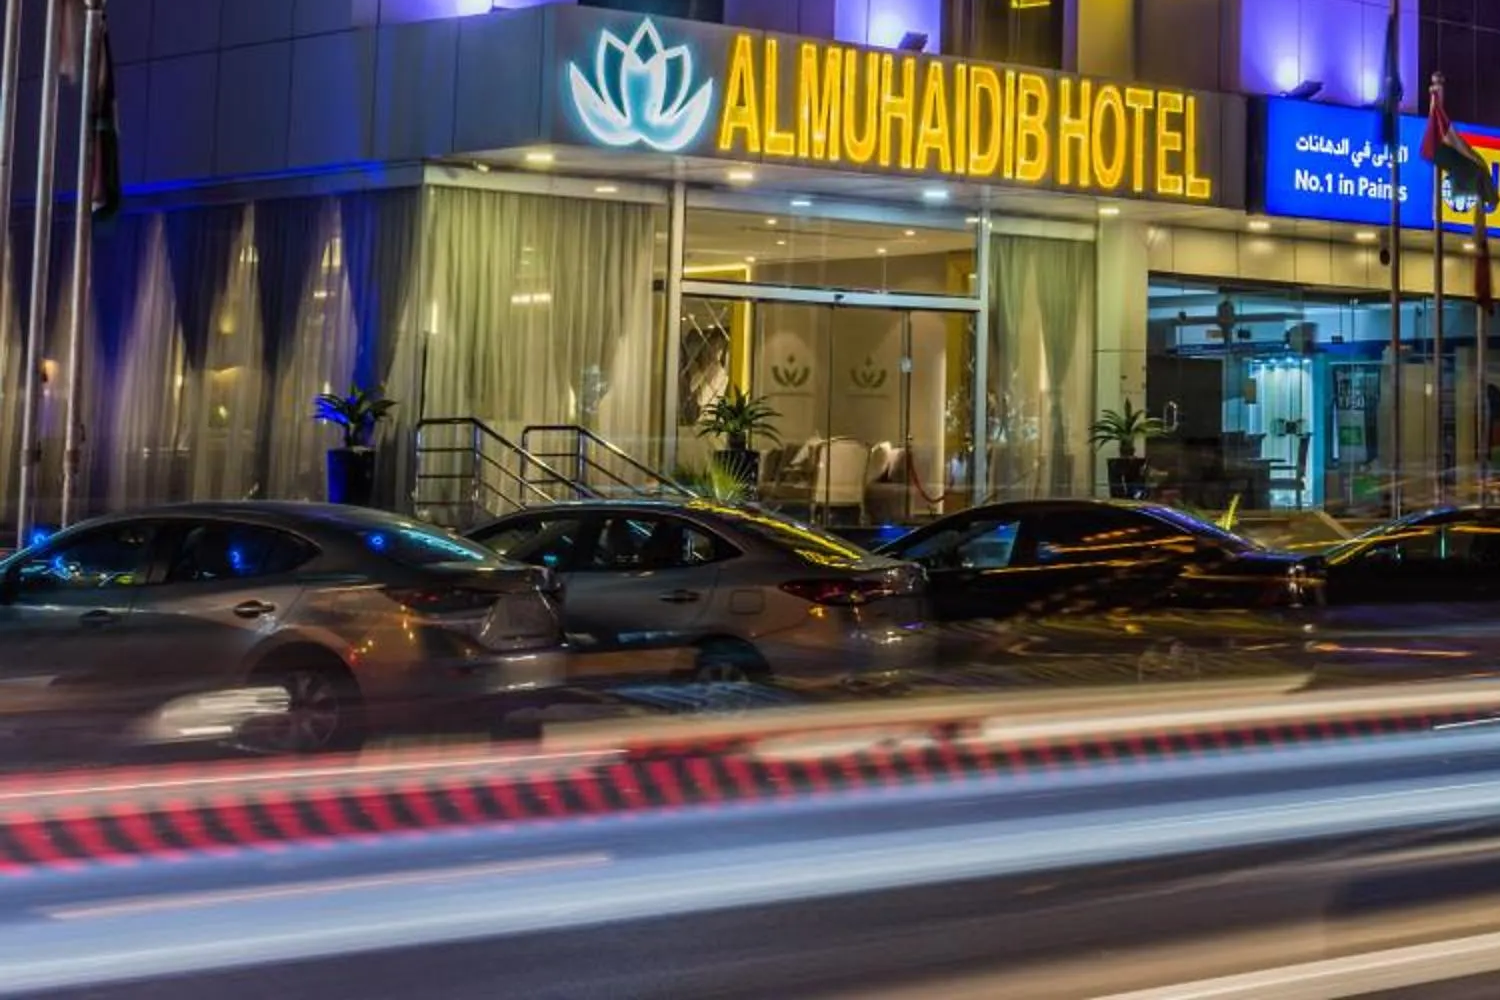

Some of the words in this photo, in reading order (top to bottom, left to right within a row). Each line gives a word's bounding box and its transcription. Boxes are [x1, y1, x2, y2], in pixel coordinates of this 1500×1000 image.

[1059, 79, 1212, 199] HOTEL
[1296, 134, 1350, 156] الدهانات
[1351, 139, 1372, 168] في
[1295, 168, 1333, 194] No.1
[1338, 173, 1355, 196] in
[1358, 176, 1408, 202] Pains
